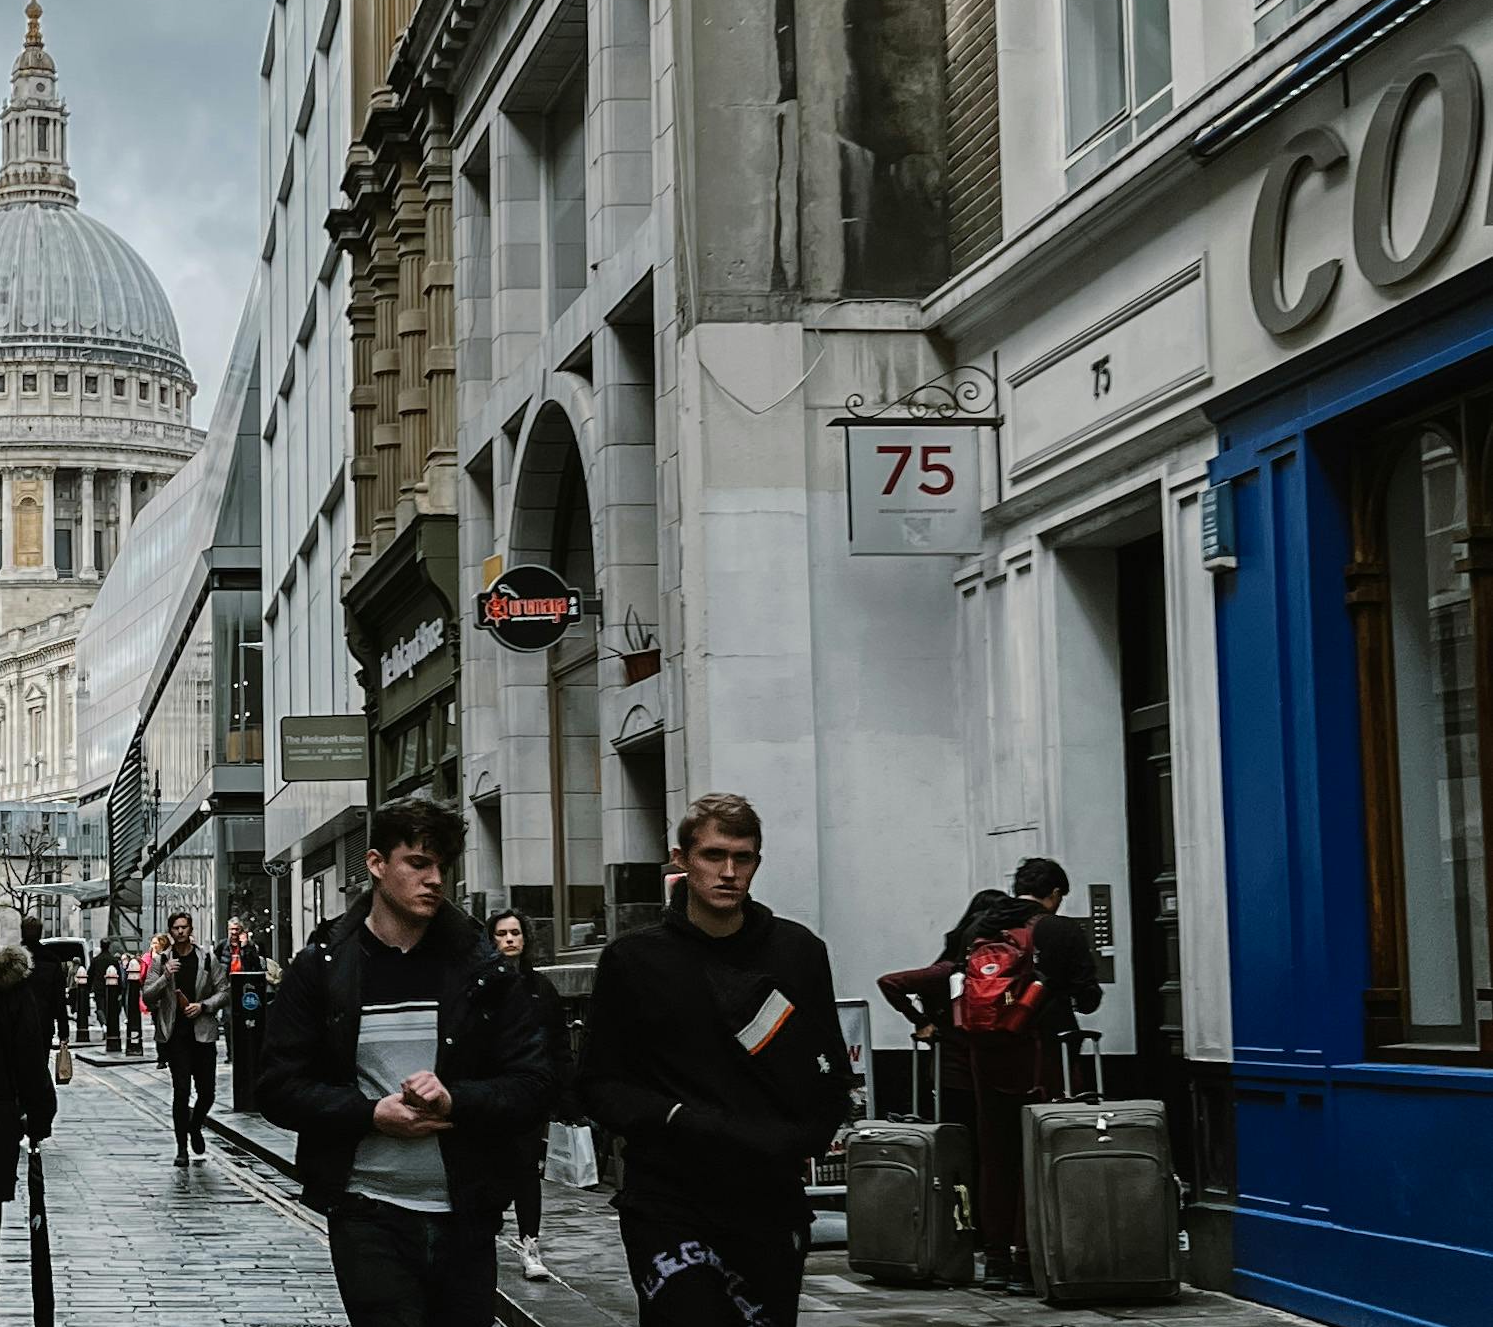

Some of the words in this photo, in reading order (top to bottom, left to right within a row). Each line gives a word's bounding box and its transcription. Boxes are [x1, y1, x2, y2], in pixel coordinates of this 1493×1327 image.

[1249, 42, 1493, 336] CO
[875, 445, 955, 496] 75
[284, 735, 300, 744] The
